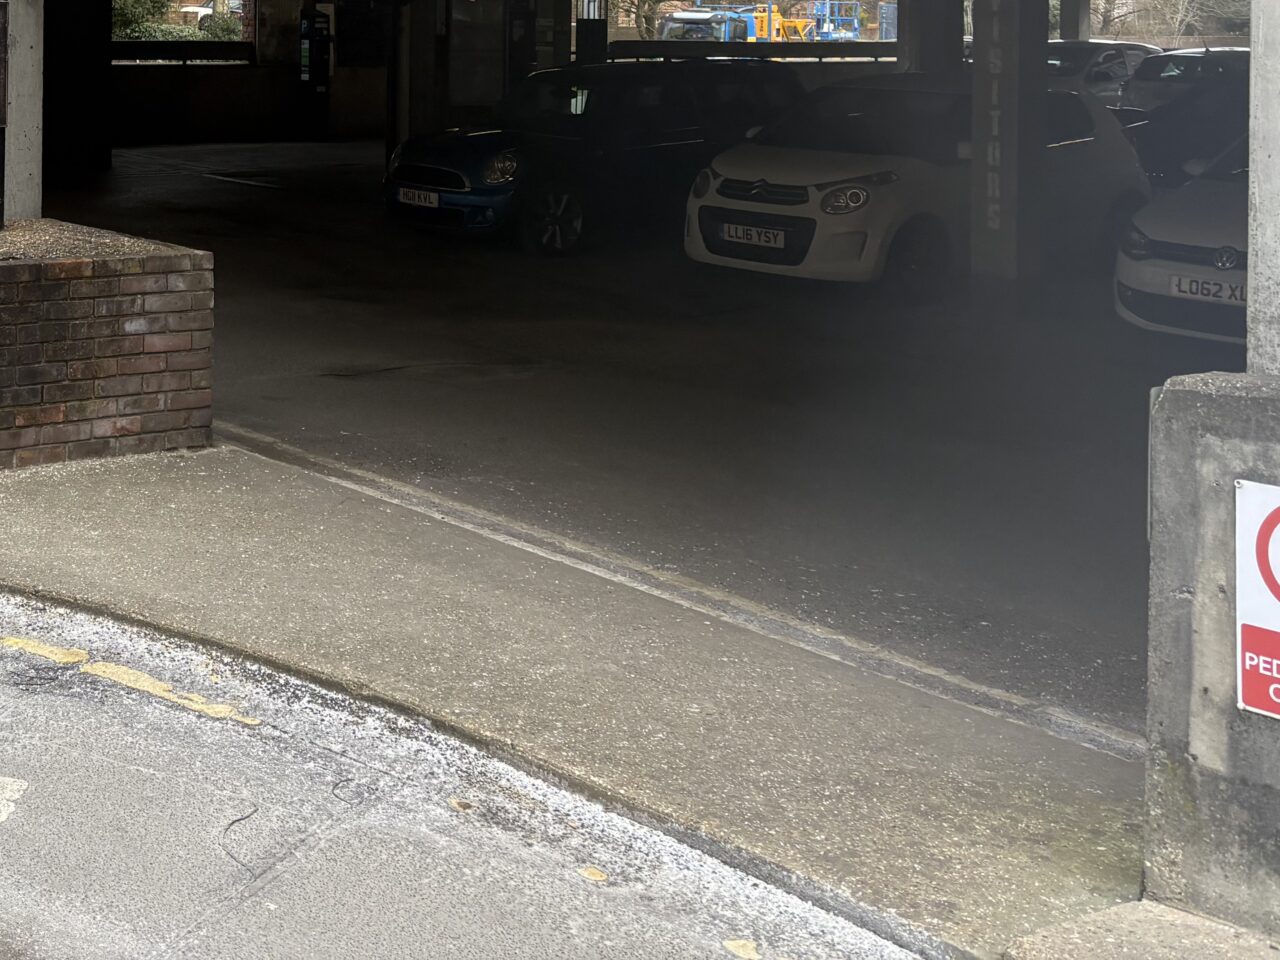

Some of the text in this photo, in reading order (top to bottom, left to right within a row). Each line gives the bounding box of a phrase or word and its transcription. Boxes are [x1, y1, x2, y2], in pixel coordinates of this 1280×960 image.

[417, 192, 434, 204] KVL
[727, 224, 780, 245] LL16 YSY
